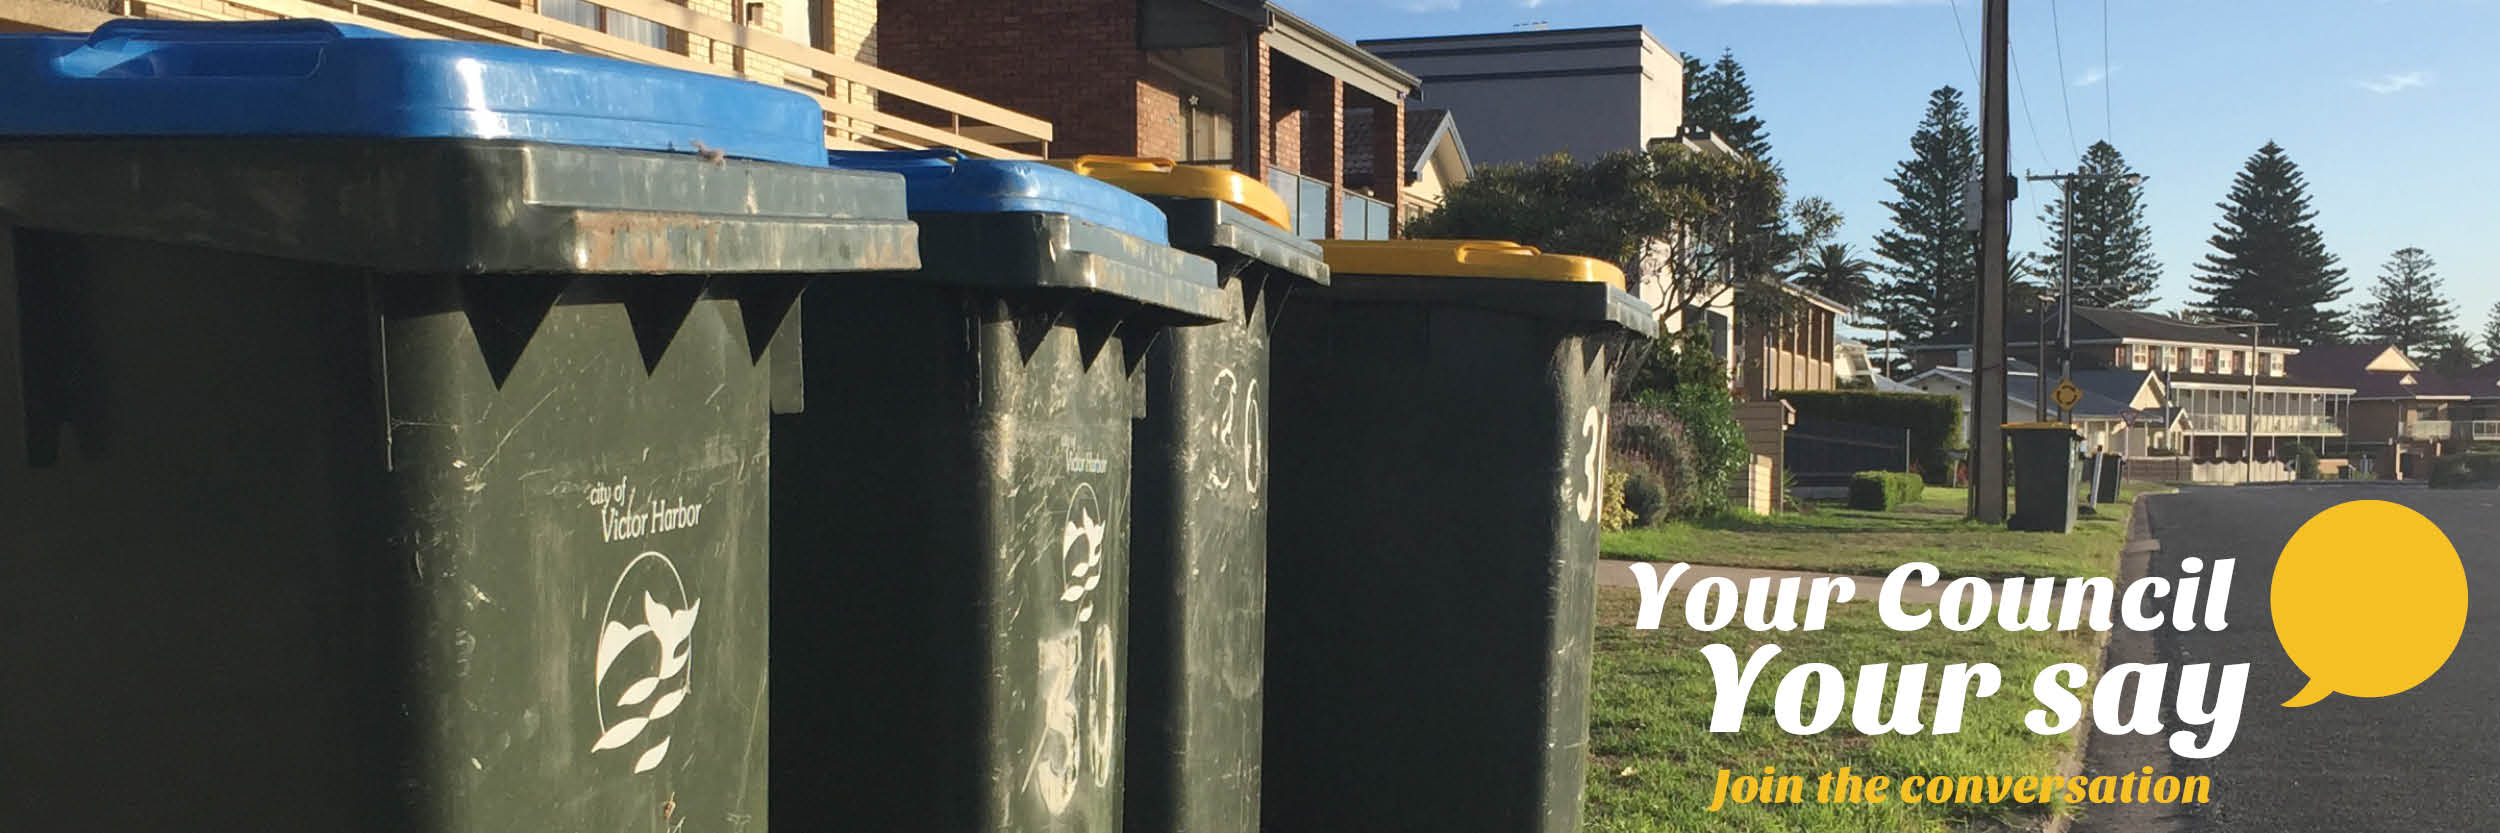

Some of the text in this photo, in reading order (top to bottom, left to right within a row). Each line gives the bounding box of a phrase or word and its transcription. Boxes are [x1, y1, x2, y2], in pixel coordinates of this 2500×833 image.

[589, 475, 628, 510] city of
[601, 495, 702, 543] Victor Harbor
